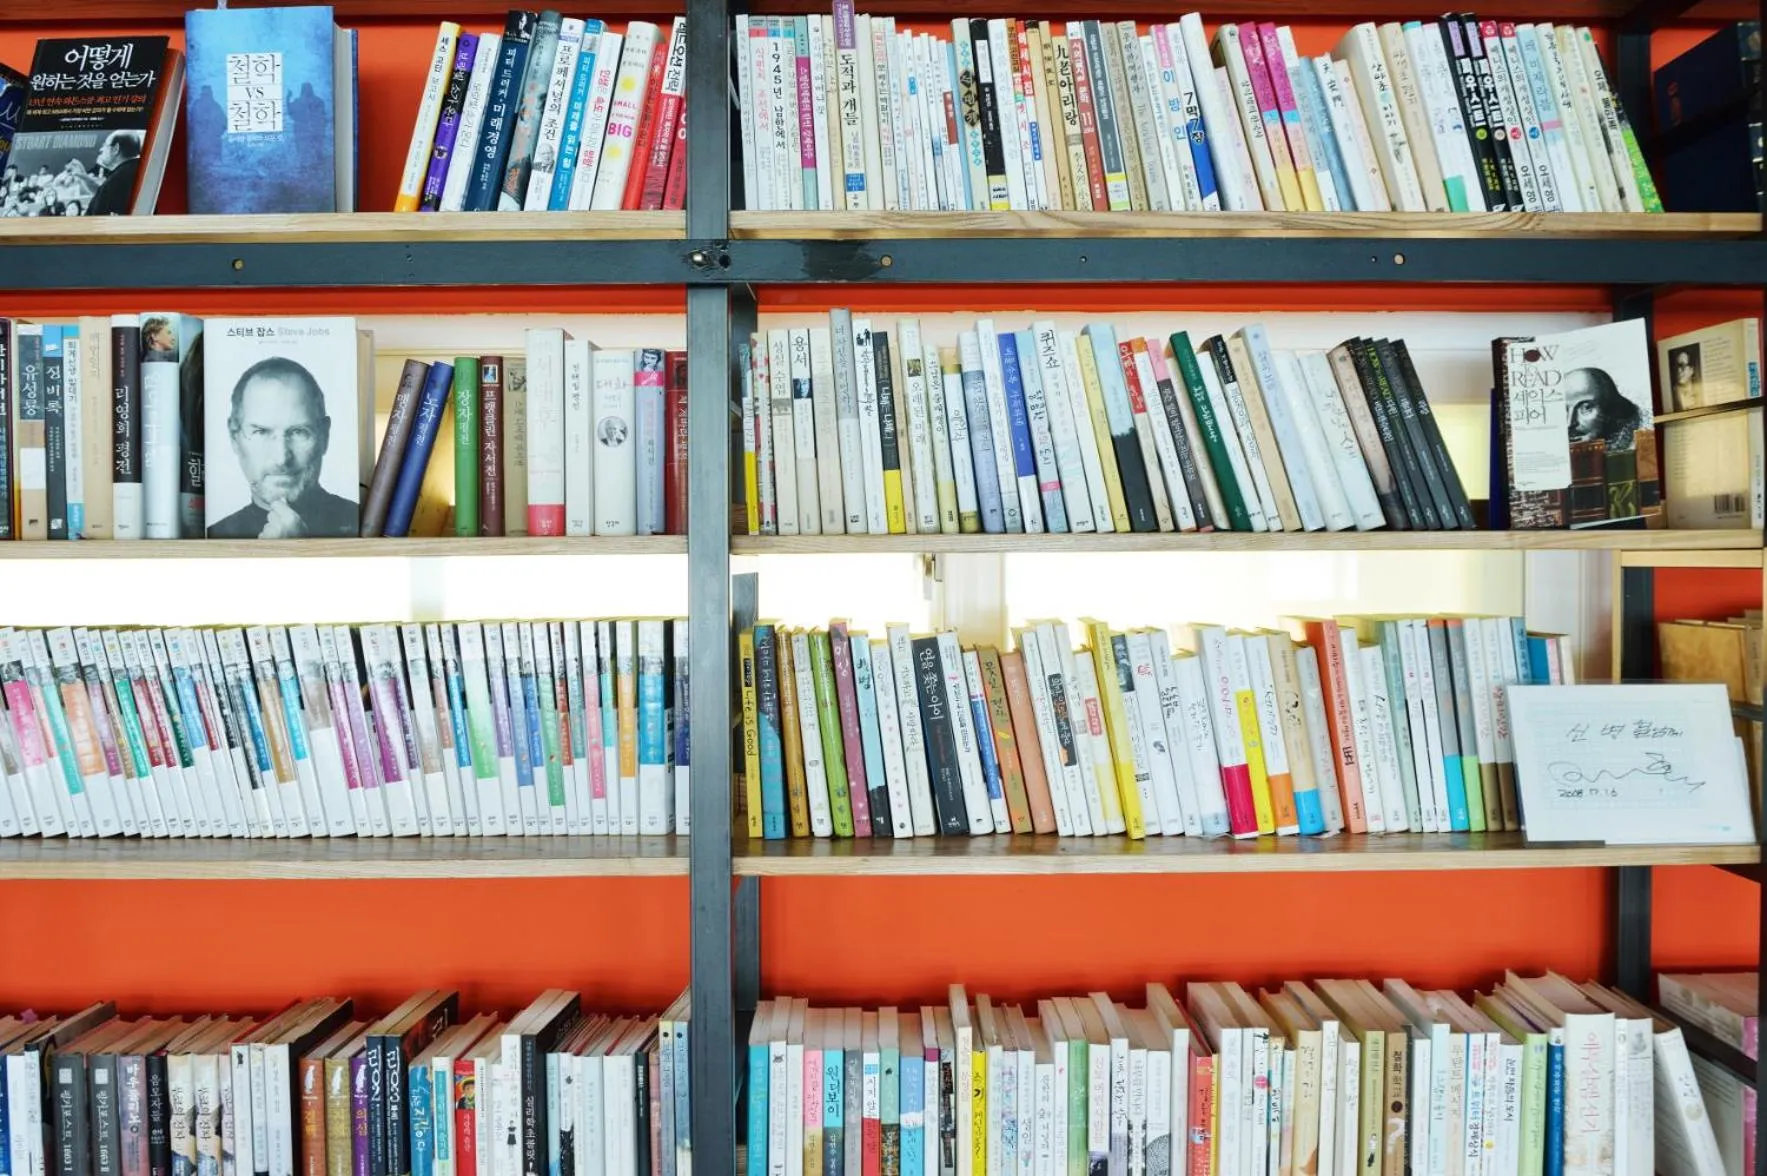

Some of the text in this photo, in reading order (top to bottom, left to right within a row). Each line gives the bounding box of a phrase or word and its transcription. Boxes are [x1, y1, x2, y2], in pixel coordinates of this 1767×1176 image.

[65, 44, 133, 71] 어떻게
[229, 54, 281, 86] 철학
[31, 70, 156, 91] 원하는 것을 얻는가
[665, 68, 680, 91] 전략
[770, 41, 785, 149] 1945년 남한에서
[839, 52, 857, 126] 도적과 개들
[229, 100, 281, 132] 철학
[608, 122, 632, 138] BIG
[1183, 90, 1205, 145] 7막7장
[226, 327, 274, 337] 스티브 잡스
[278, 327, 330, 336] Steve Jobs
[791, 335, 807, 368] 용서
[1038, 329, 1060, 369] 퀴즈쇼
[22, 366, 40, 416] 유성룡
[46, 366, 62, 414] 징비록
[1511, 369, 1562, 388] READ
[1513, 408, 1547, 425] 피어
[484, 390, 496, 476] 프랭클린 자서전
[115, 441, 131, 474] 평전
[918, 647, 943, 720] 연을 쫓는 아이
[744, 689, 753, 711] Life
[746, 728, 756, 755] Good
[61, 1090, 71, 1141] 핑거포스트
[94, 1090, 106, 1141] 핑거포스트
[1503, 1105, 1514, 1121] 도시
[1580, 1103, 1601, 1133] 전기
